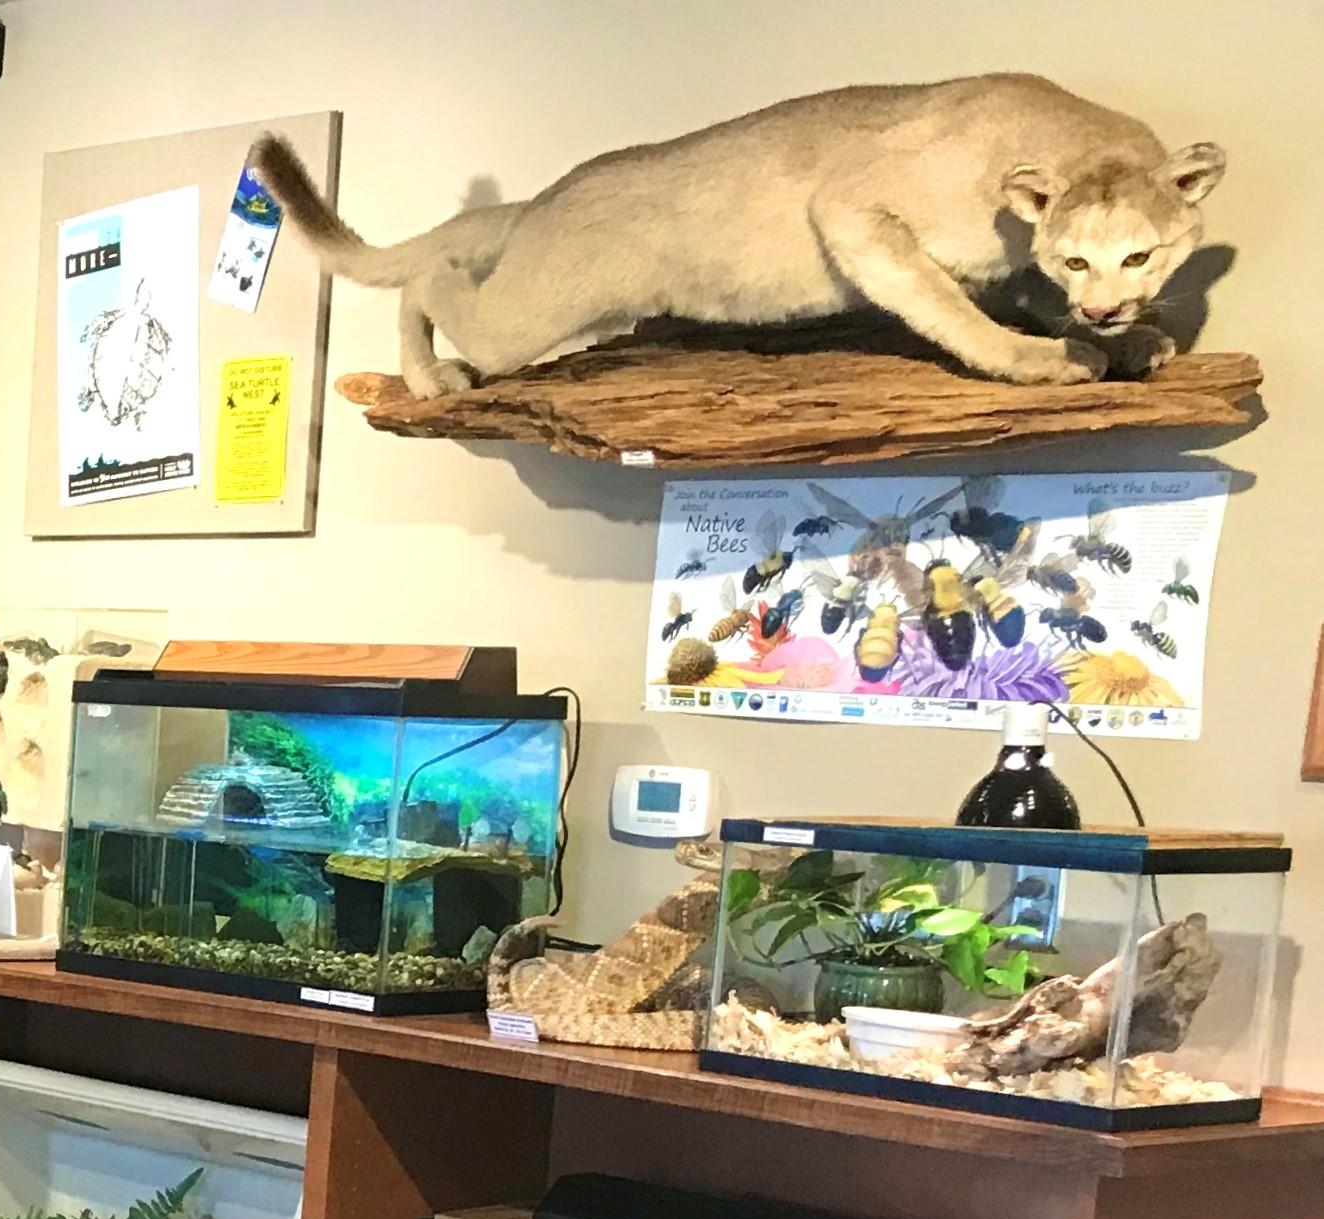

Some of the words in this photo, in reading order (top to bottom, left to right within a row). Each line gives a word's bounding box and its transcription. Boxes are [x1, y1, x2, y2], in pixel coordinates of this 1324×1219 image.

[230, 381, 245, 390] SEA
[248, 377, 280, 388] TURTLE
[243, 389, 265, 399] NEST
[674, 489, 696, 500] Join
[698, 489, 715, 500] the
[719, 488, 789, 500] Conversation
[1073, 481, 1118, 495] What's
[1123, 481, 1145, 494] the
[1150, 480, 1190, 495] buzz?
[680, 502, 708, 512] about
[686, 512, 746, 533] Native
[706, 534, 748, 553] Bees
